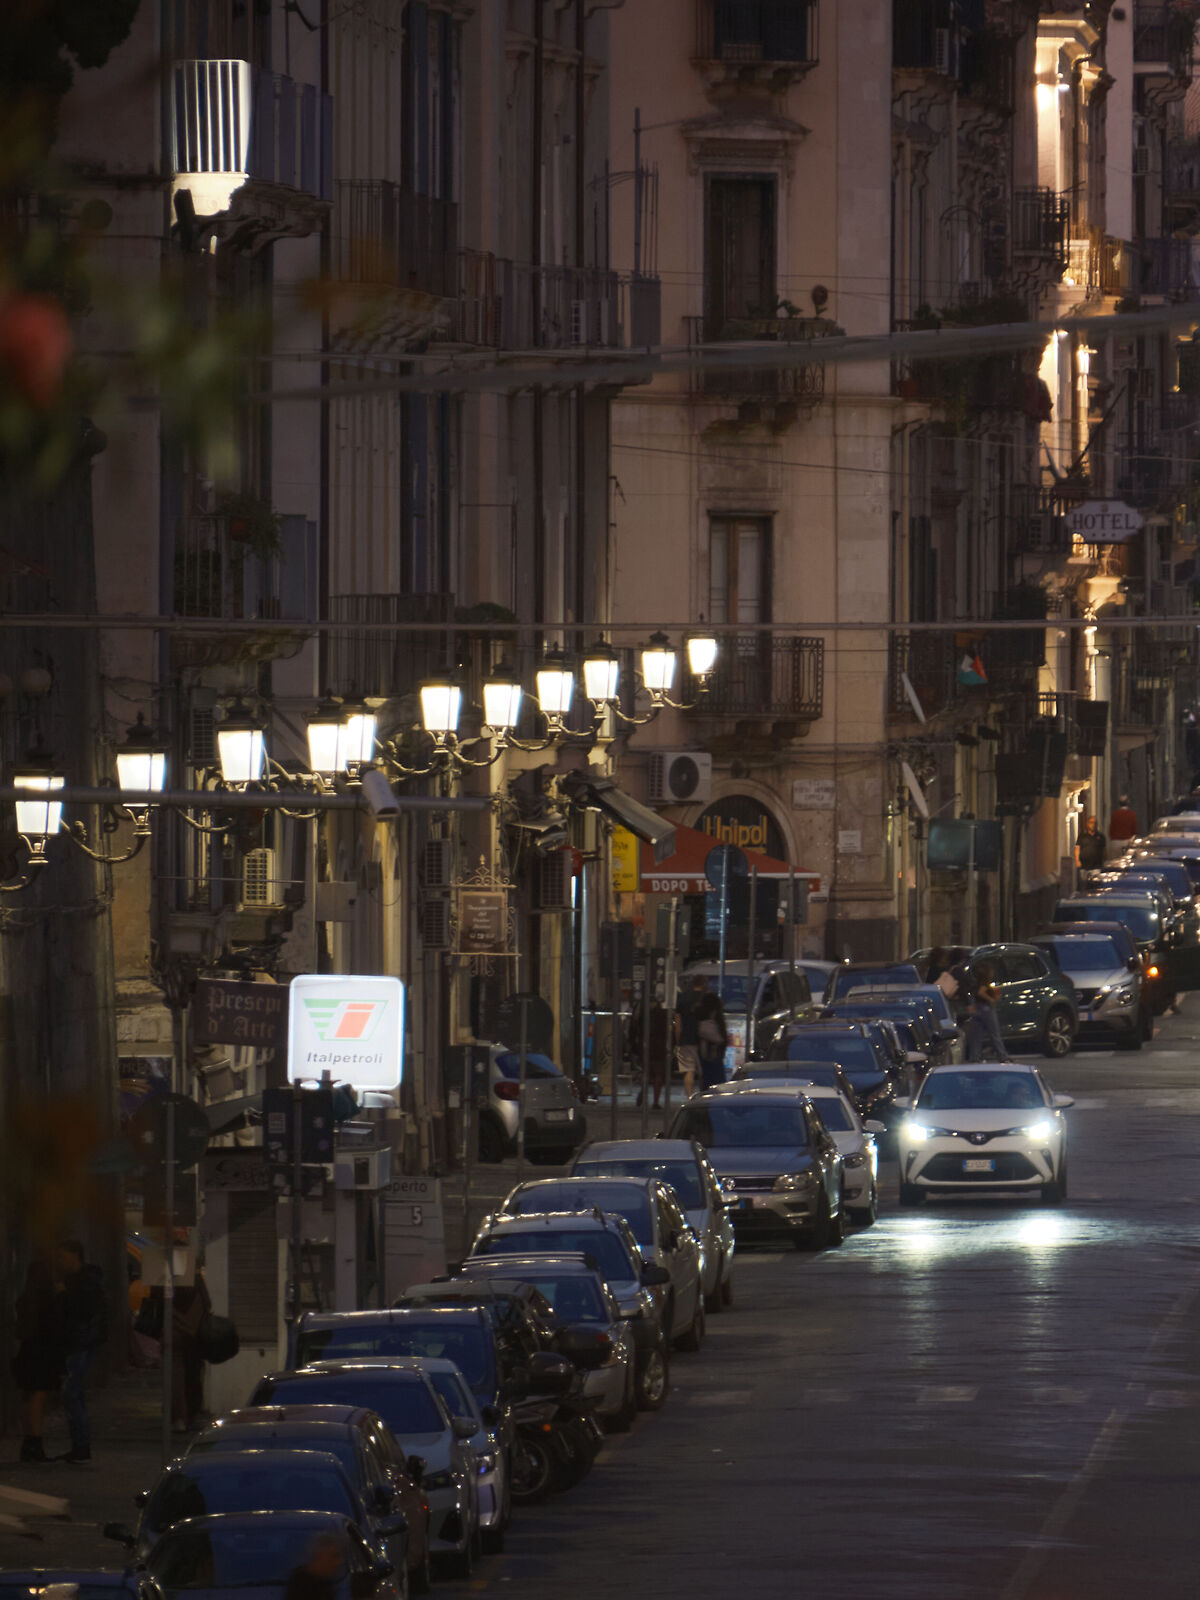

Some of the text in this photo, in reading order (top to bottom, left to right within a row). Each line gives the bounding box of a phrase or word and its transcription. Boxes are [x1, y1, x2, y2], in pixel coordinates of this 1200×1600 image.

[1073, 513, 1135, 530] HOTEL
[651, 879, 688, 892] DOPO
[306, 1052, 384, 1066] Italpetroli
[411, 1206, 422, 1225] 5
